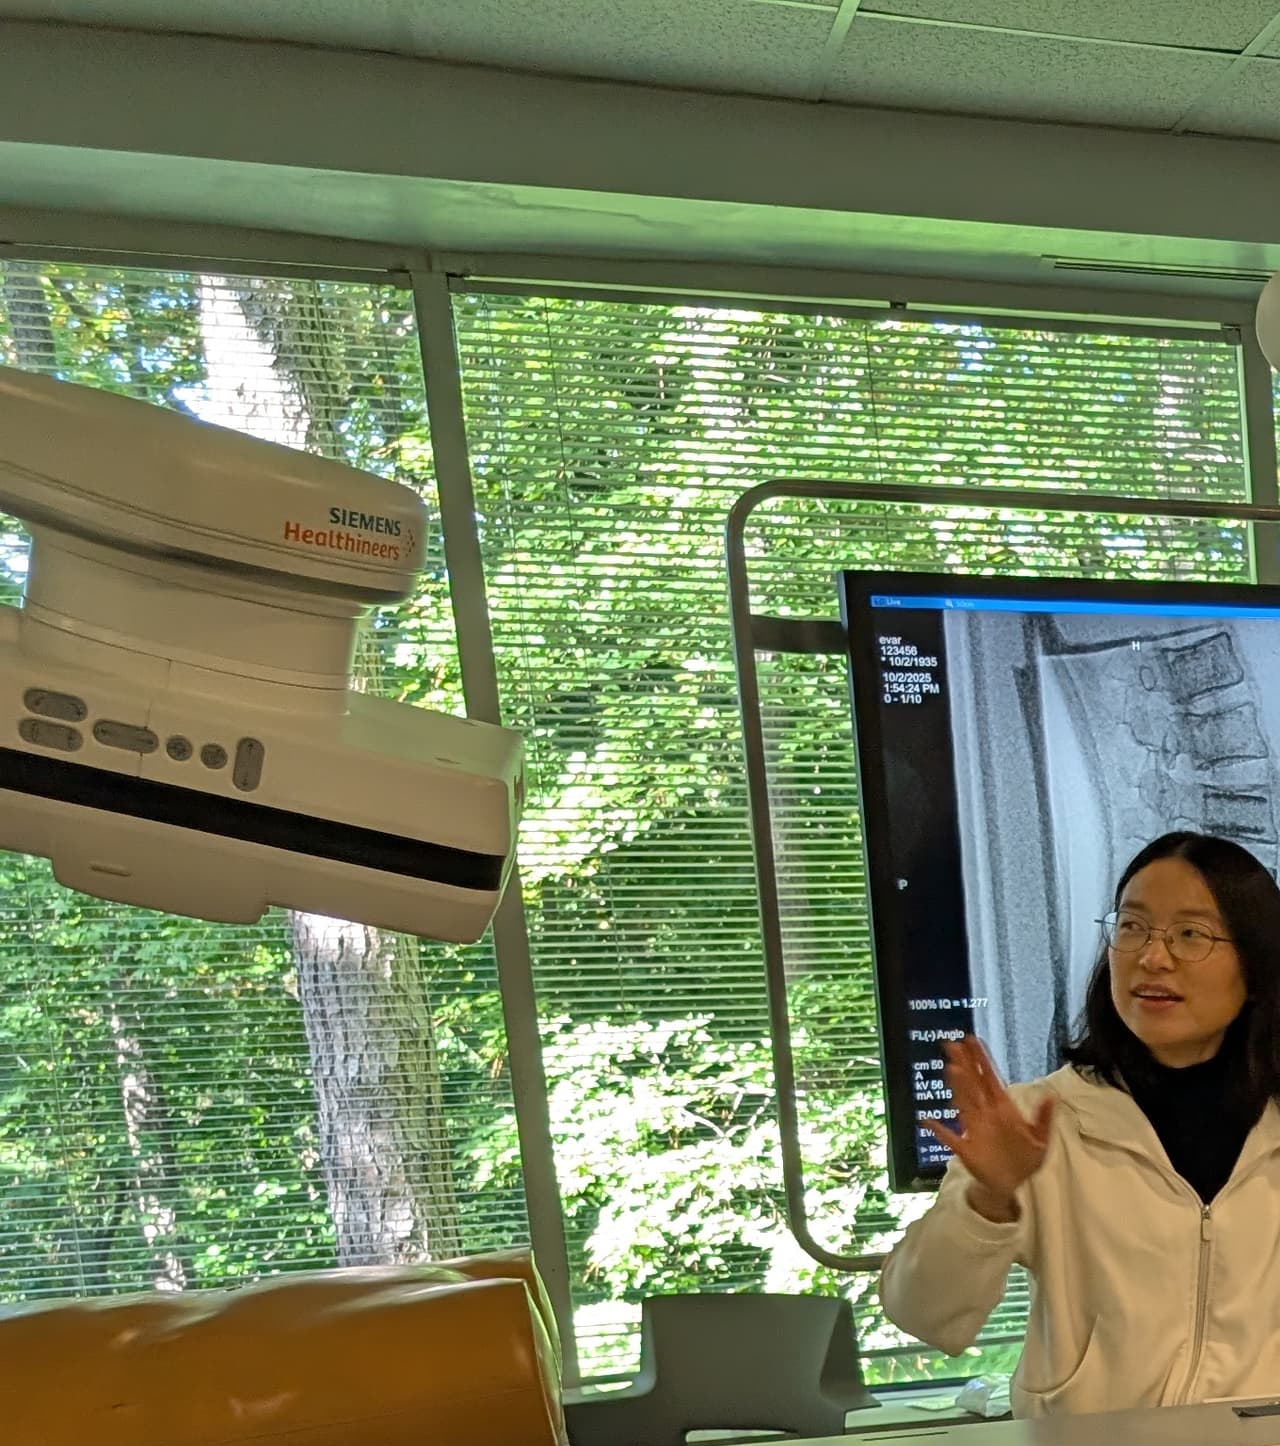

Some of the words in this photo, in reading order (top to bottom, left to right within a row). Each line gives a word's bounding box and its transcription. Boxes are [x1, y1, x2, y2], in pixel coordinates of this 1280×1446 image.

[329, 507, 401, 537] SIEMENS
[284, 520, 400, 561] Healthineers
[879, 636, 902, 645] evar
[1131, 640, 1141, 651] H
[880, 645, 918, 656] 123456
[889, 656, 938, 667] 10/2/1935
[882, 671, 932, 683] 10/2/2025
[883, 683, 920, 694] 1:54:24
[922, 683, 940, 694] PM
[900, 694, 922, 704] 1/10
[910, 1000, 938, 1010] 100%
[938, 999, 952, 1010] IQ
[961, 998, 989, 1009] 1.277
[911, 1031, 936, 1041] FL(-)
[936, 1029, 965, 1041] Angio
[914, 1062, 930, 1071] cm
[931, 1060, 945, 1070] 50
[915, 1071, 925, 1081] A
[916, 1080, 930, 1091] kV
[917, 1091, 934, 1101] mA
[935, 1089, 953, 1100] 115
[919, 1109, 942, 1121] RAO
